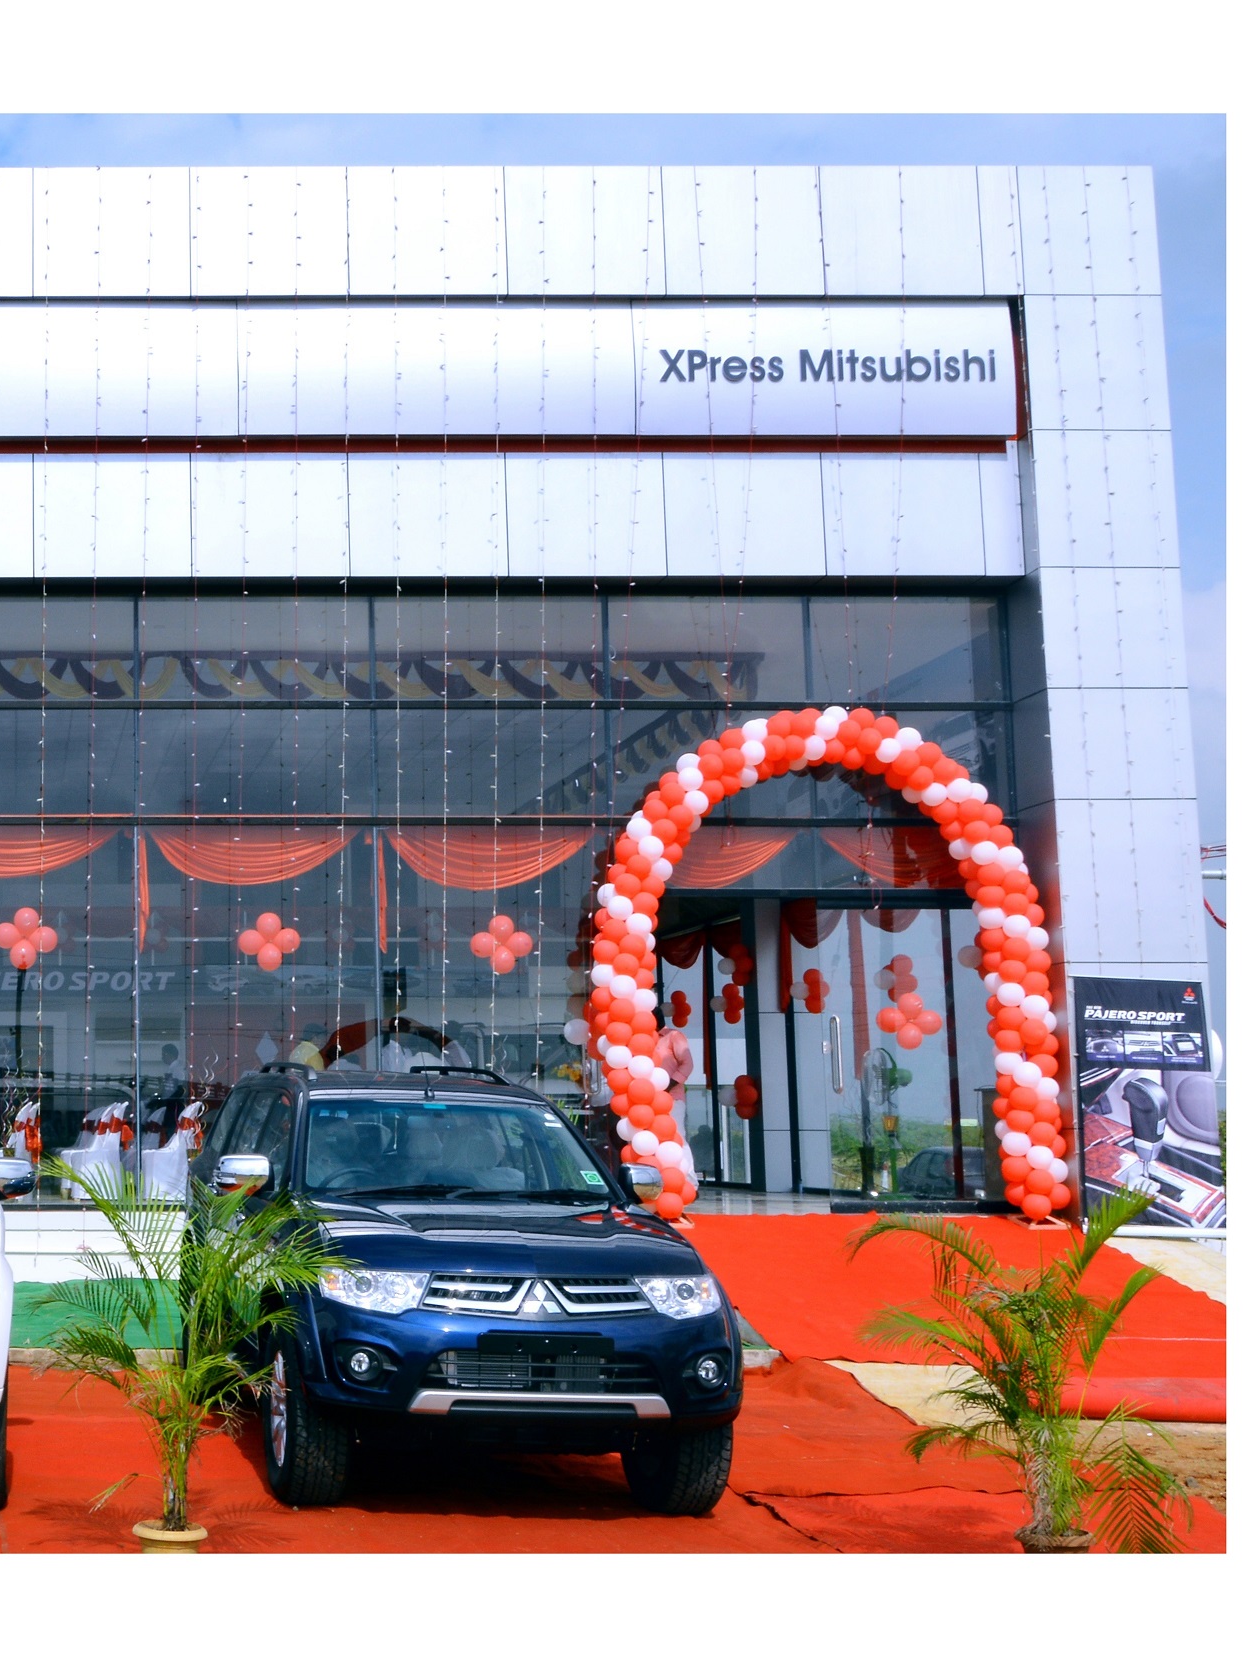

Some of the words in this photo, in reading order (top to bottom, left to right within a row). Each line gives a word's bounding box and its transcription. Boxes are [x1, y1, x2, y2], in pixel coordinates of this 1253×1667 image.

[659, 349, 785, 383] XPress
[799, 348, 997, 383] Mitsubishi
[68, 971, 177, 992] SPORT
[1084, 1009, 1137, 1020] PAJERO
[1137, 1011, 1185, 1021] SPORT
